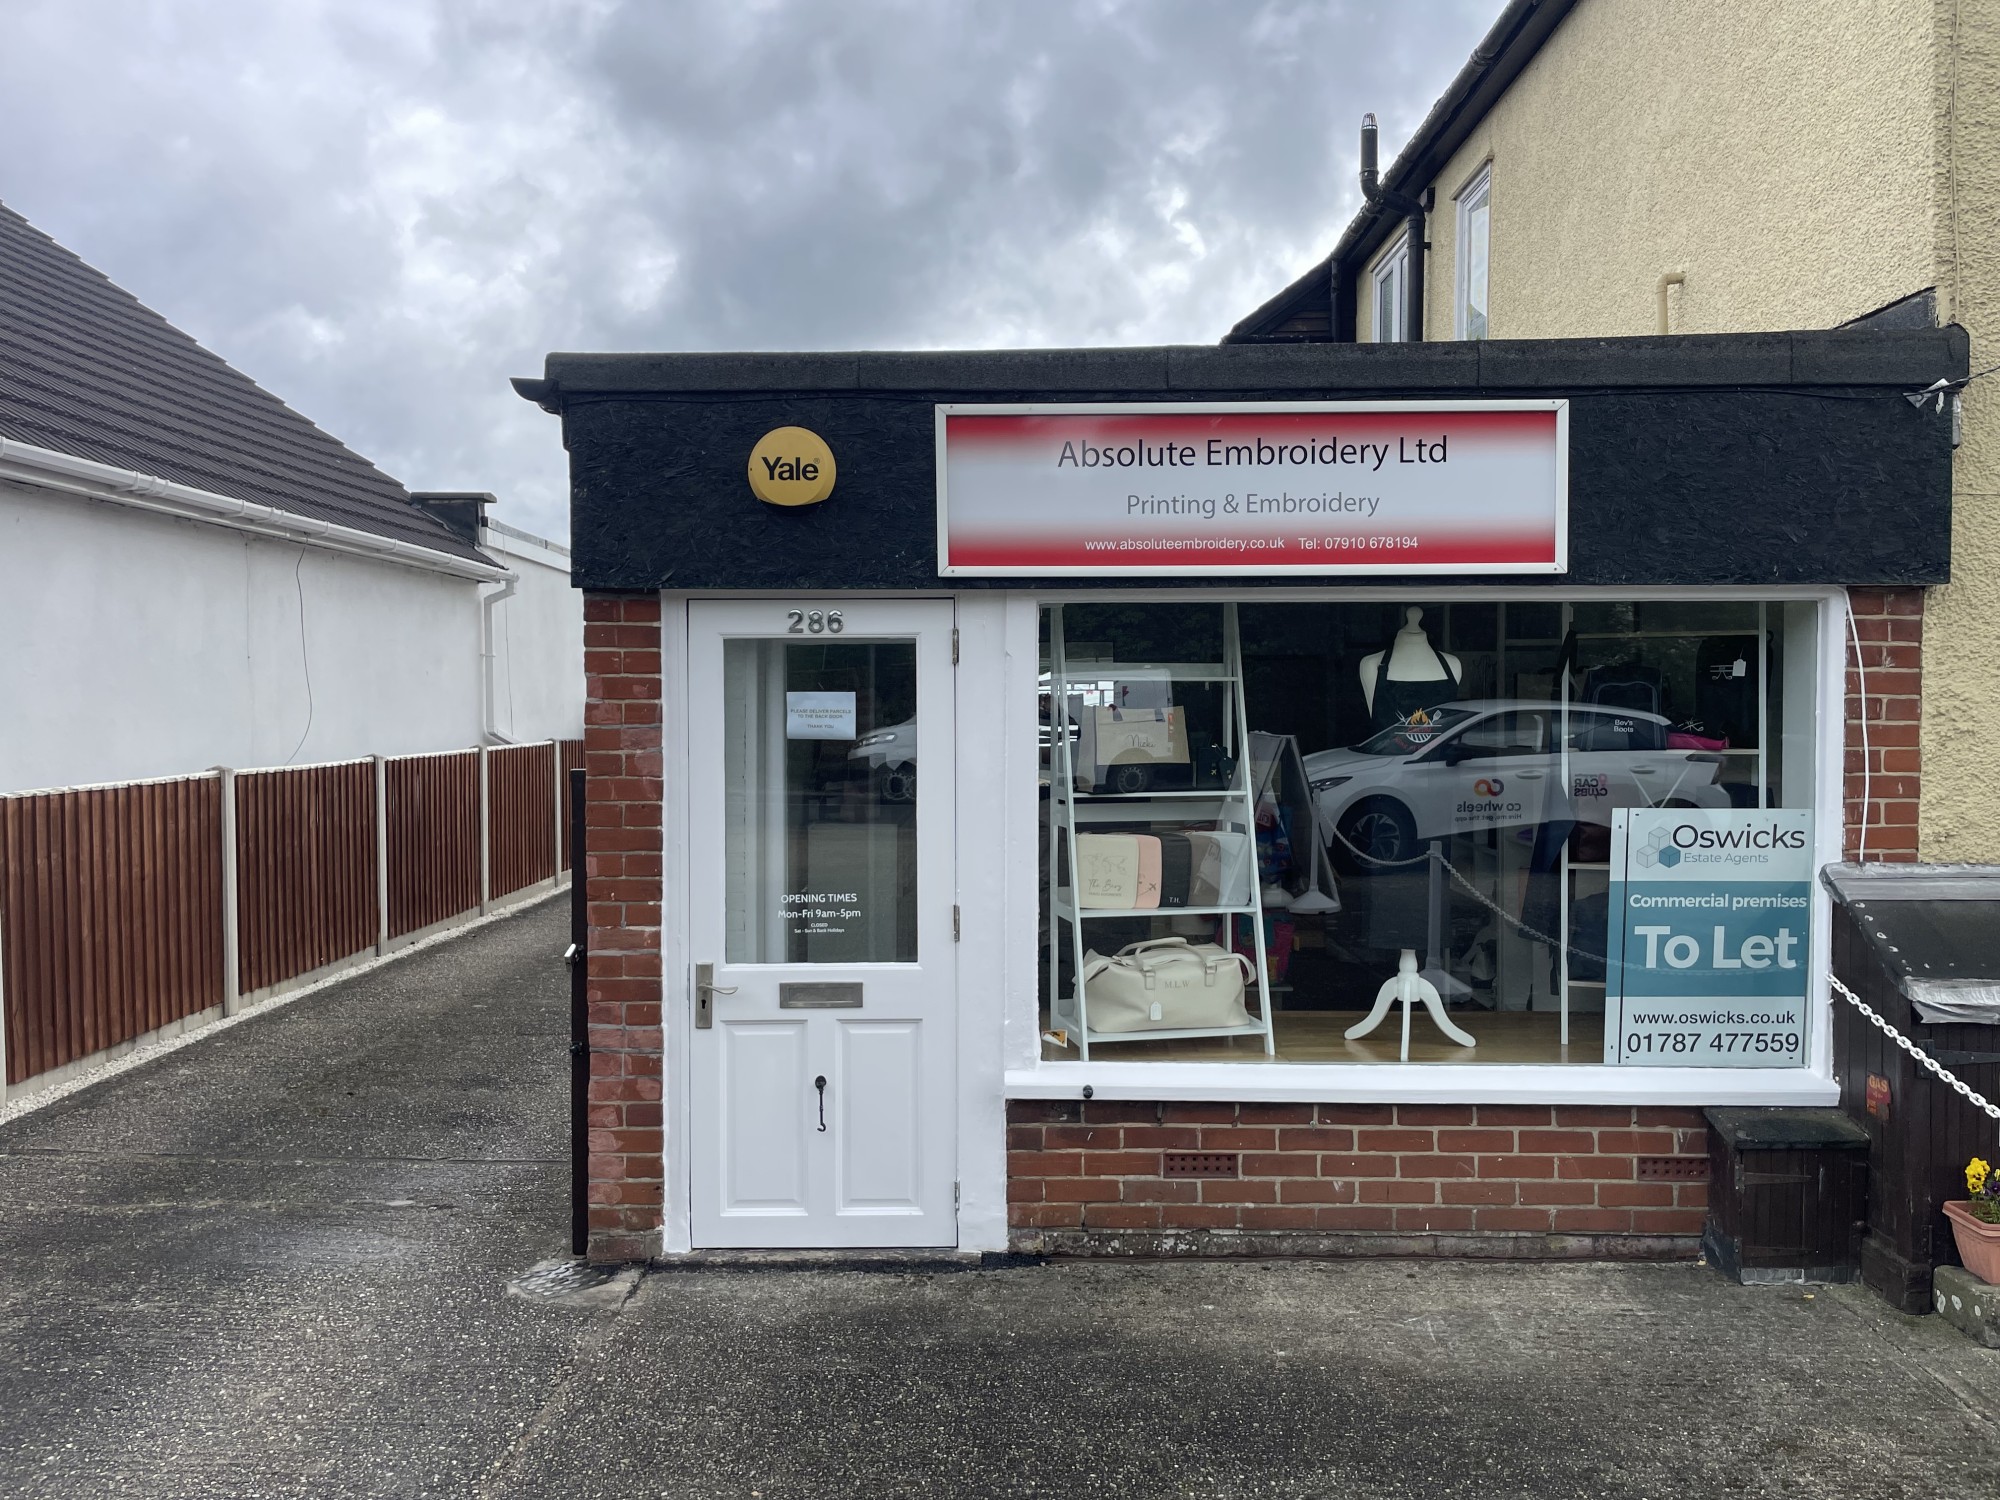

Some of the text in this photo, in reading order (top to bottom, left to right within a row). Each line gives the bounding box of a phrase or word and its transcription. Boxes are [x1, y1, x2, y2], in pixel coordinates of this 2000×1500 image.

[1057, 434, 1447, 472] Absolute Embroidery Ltd
[1127, 491, 1380, 520] Printing & Embroidery
[1085, 535, 1419, 552] www.absoluteembroidery.co.uk Tel: 07910 678194
[787, 608, 844, 634] 286
[1672, 823, 1805, 849] Oswicks
[1683, 852, 1769, 866] Estate Agents
[781, 893, 857, 903] OPENING TIMES
[1629, 893, 1807, 911] Commercial premises
[778, 909, 861, 920] Mon-Fri 9am-5pm
[1634, 925, 1798, 969] To Let
[1633, 1010, 1795, 1024] www.oswicks.co.uk
[1627, 1033, 1799, 1053] 01787 477559
[1869, 1074, 1888, 1092] GAS
